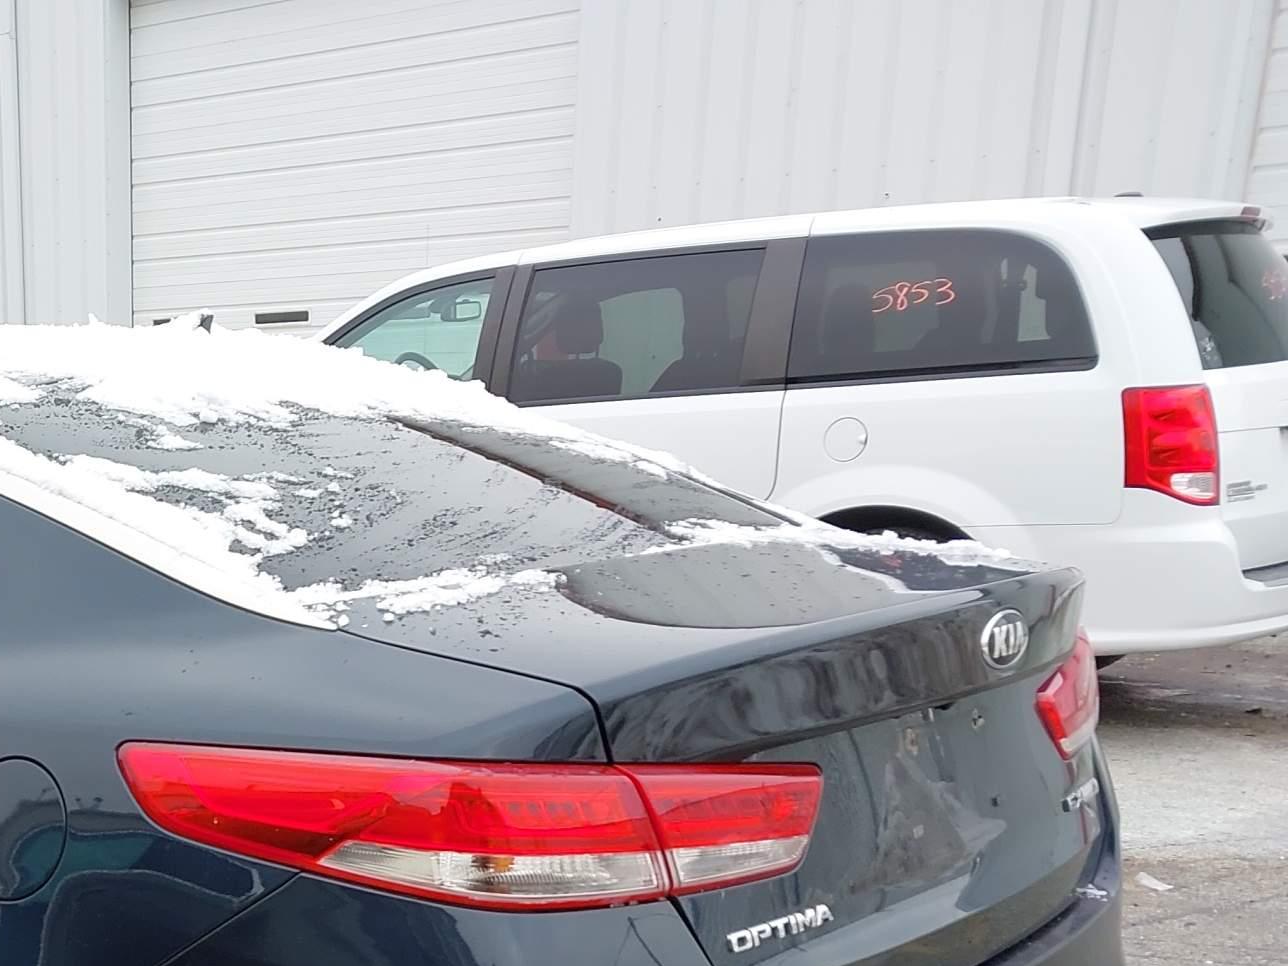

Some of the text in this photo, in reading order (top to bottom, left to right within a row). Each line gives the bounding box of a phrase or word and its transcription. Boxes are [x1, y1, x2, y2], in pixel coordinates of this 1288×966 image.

[872, 278, 956, 313] 5853
[993, 622, 1027, 658] KIA
[726, 903, 834, 954] OPTIMA
